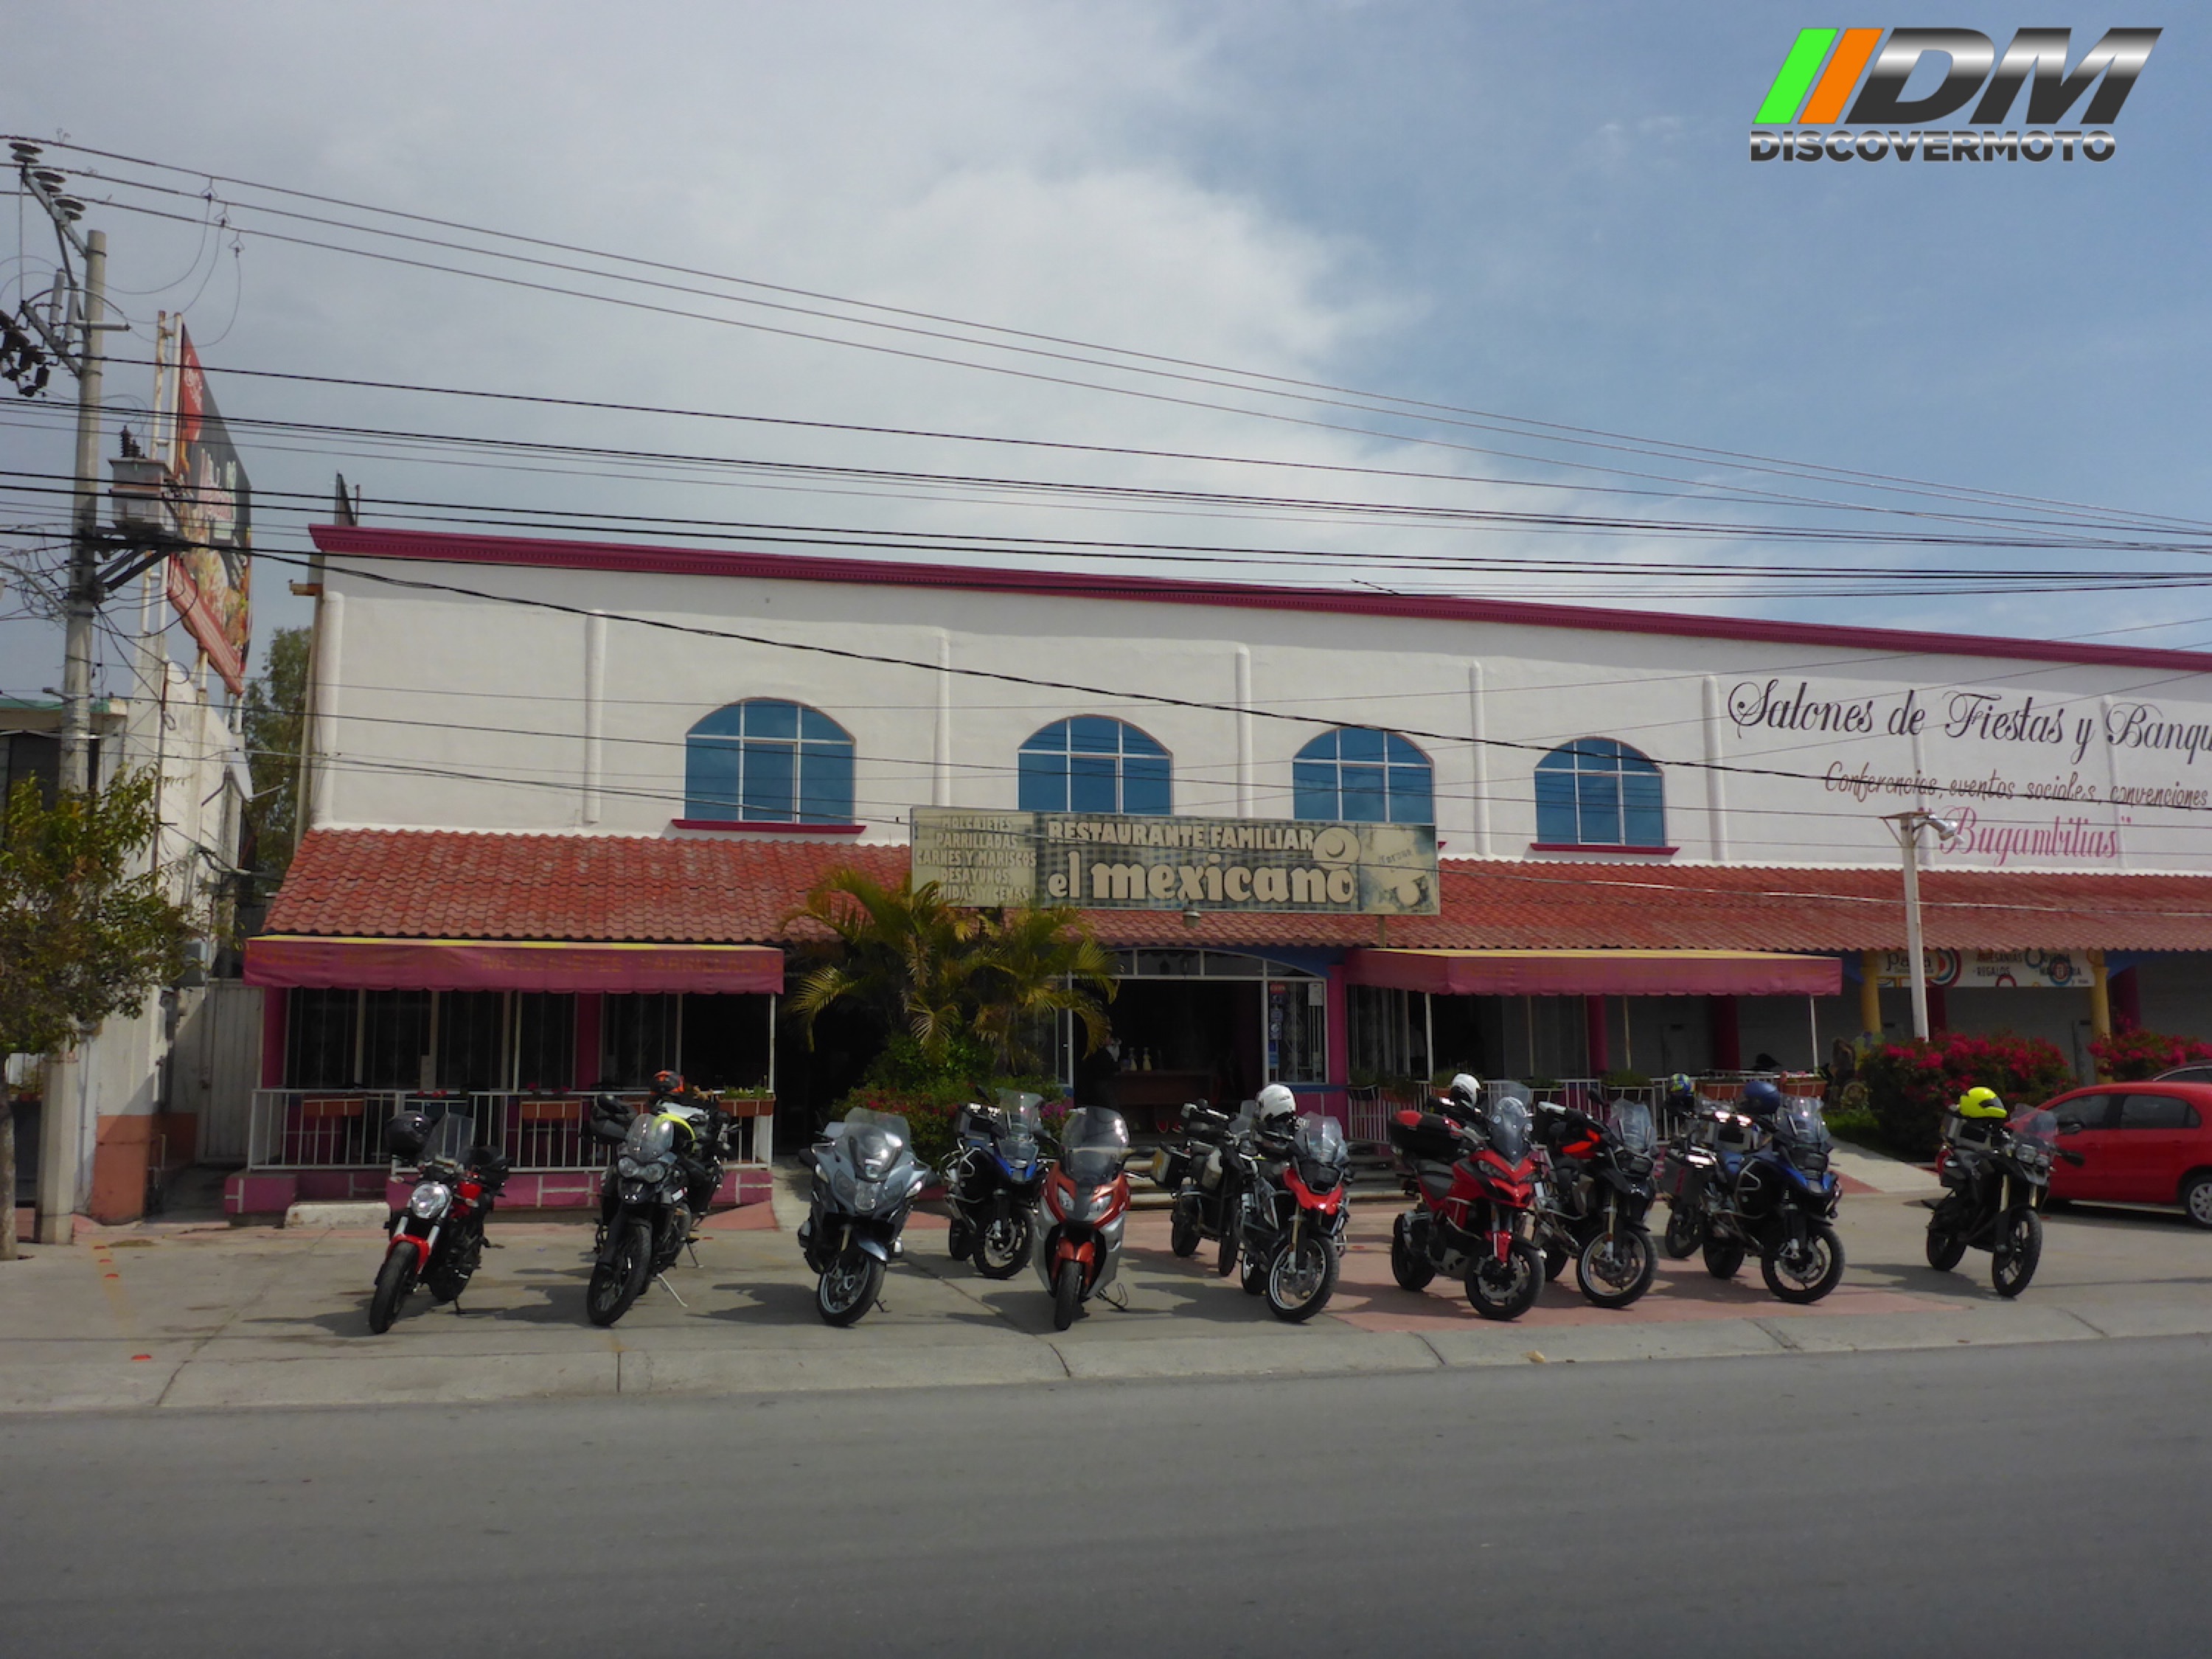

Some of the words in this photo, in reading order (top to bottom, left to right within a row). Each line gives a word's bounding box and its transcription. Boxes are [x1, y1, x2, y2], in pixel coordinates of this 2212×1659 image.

[1728, 678, 1874, 739] Salones
[1888, 689, 1926, 735] de
[1942, 690, 2065, 744] Fiestas
[2070, 717, 2096, 765] y
[1825, 760, 1944, 804] Conferencias,
[1950, 768, 2016, 801] eventos
[2110, 781, 2209, 812] convenciones
[935, 832, 1018, 849] PARRILLADAS
[1048, 821, 1204, 848] RESTAURANTE
[1210, 827, 1314, 850] FAMILIAR
[916, 849, 962, 866] CARNES
[965, 850, 974, 866] Y
[978, 850, 1037, 868] MARISCOS
[1048, 850, 1080, 898] el
[1091, 852, 1354, 904] mexicano
